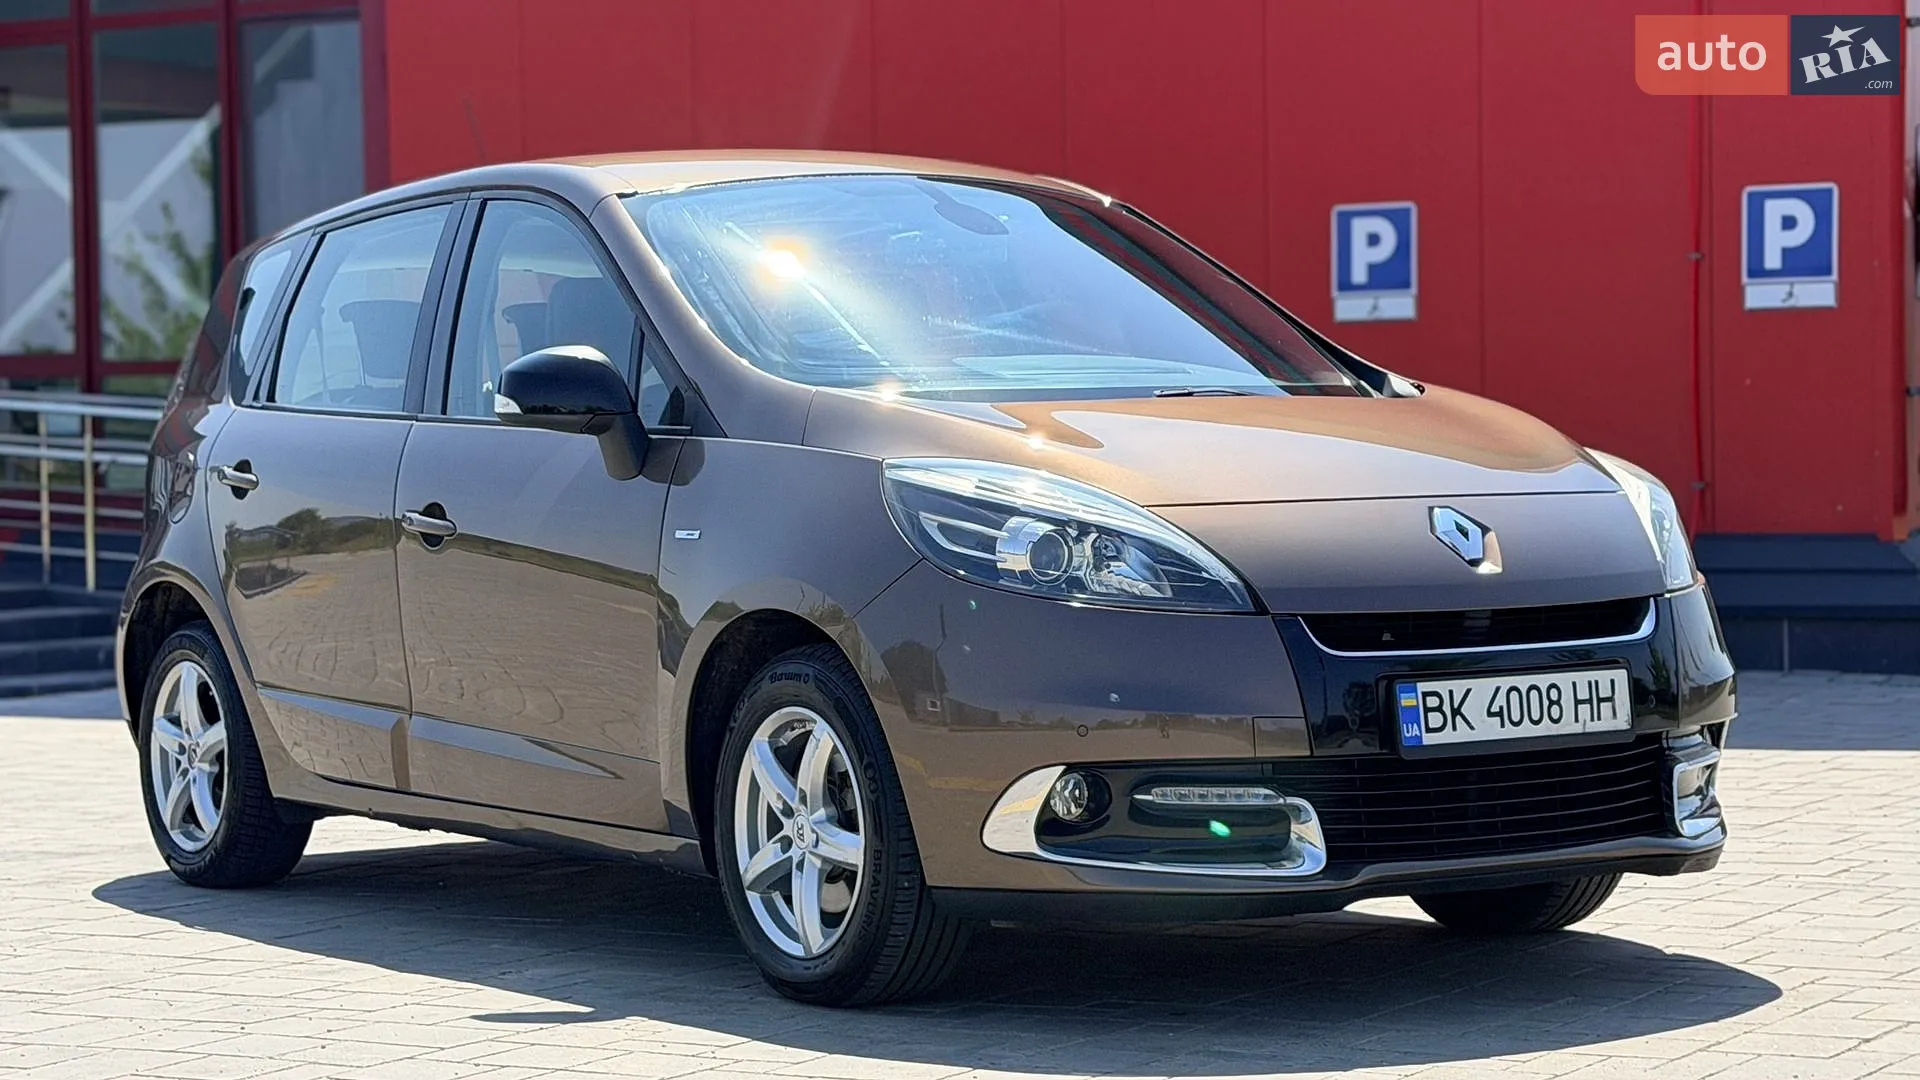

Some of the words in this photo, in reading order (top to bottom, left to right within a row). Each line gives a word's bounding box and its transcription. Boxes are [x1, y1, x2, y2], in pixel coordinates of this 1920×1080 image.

[1350, 216, 1399, 285] P
[1764, 198, 1816, 270] P
[1403, 722, 1421, 737] UA
[1421, 687, 1476, 735] BK
[1486, 682, 1564, 729] 4008
[1572, 678, 1618, 723] HH
